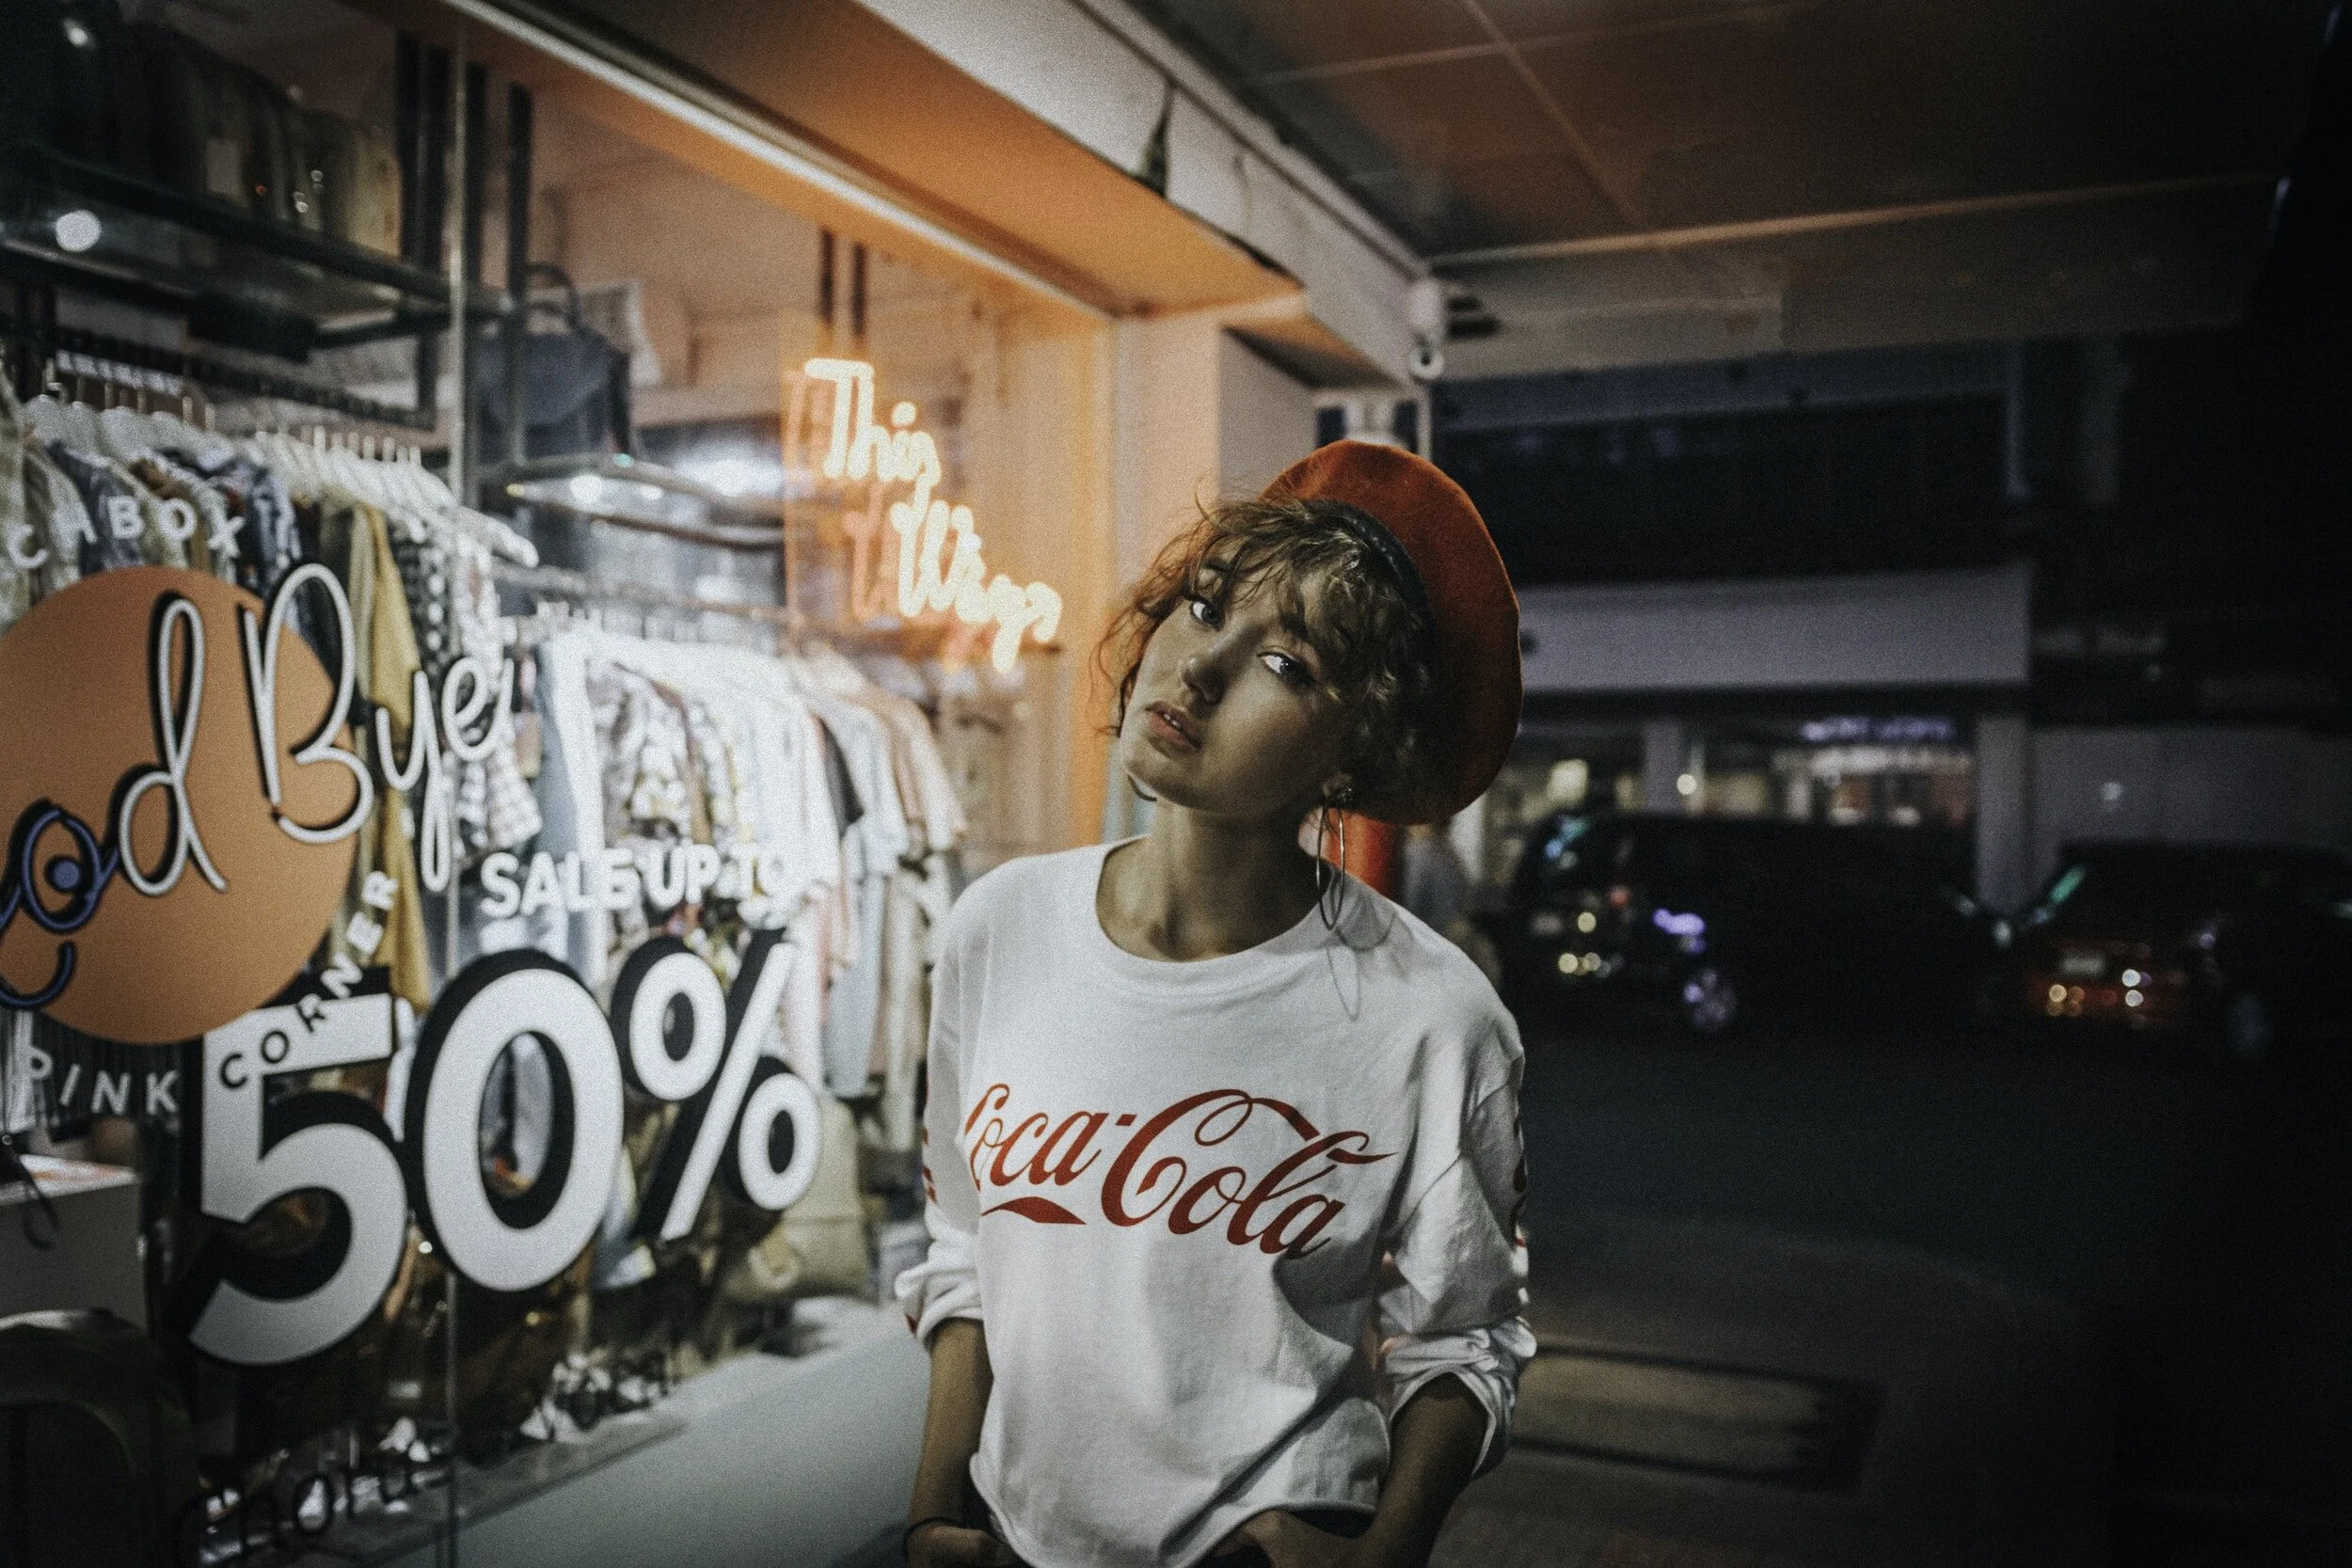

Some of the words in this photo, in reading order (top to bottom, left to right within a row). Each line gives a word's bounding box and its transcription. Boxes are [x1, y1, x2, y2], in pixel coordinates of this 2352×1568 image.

[804, 356, 942, 483] This
[243, 564, 515, 892] Bye
[17, 1046, 180, 1117] PINK
[219, 870, 399, 1089] CORNER
[480, 847, 636, 918] SALE
[646, 843, 722, 911] UP
[188, 941, 822, 1365] 50%
